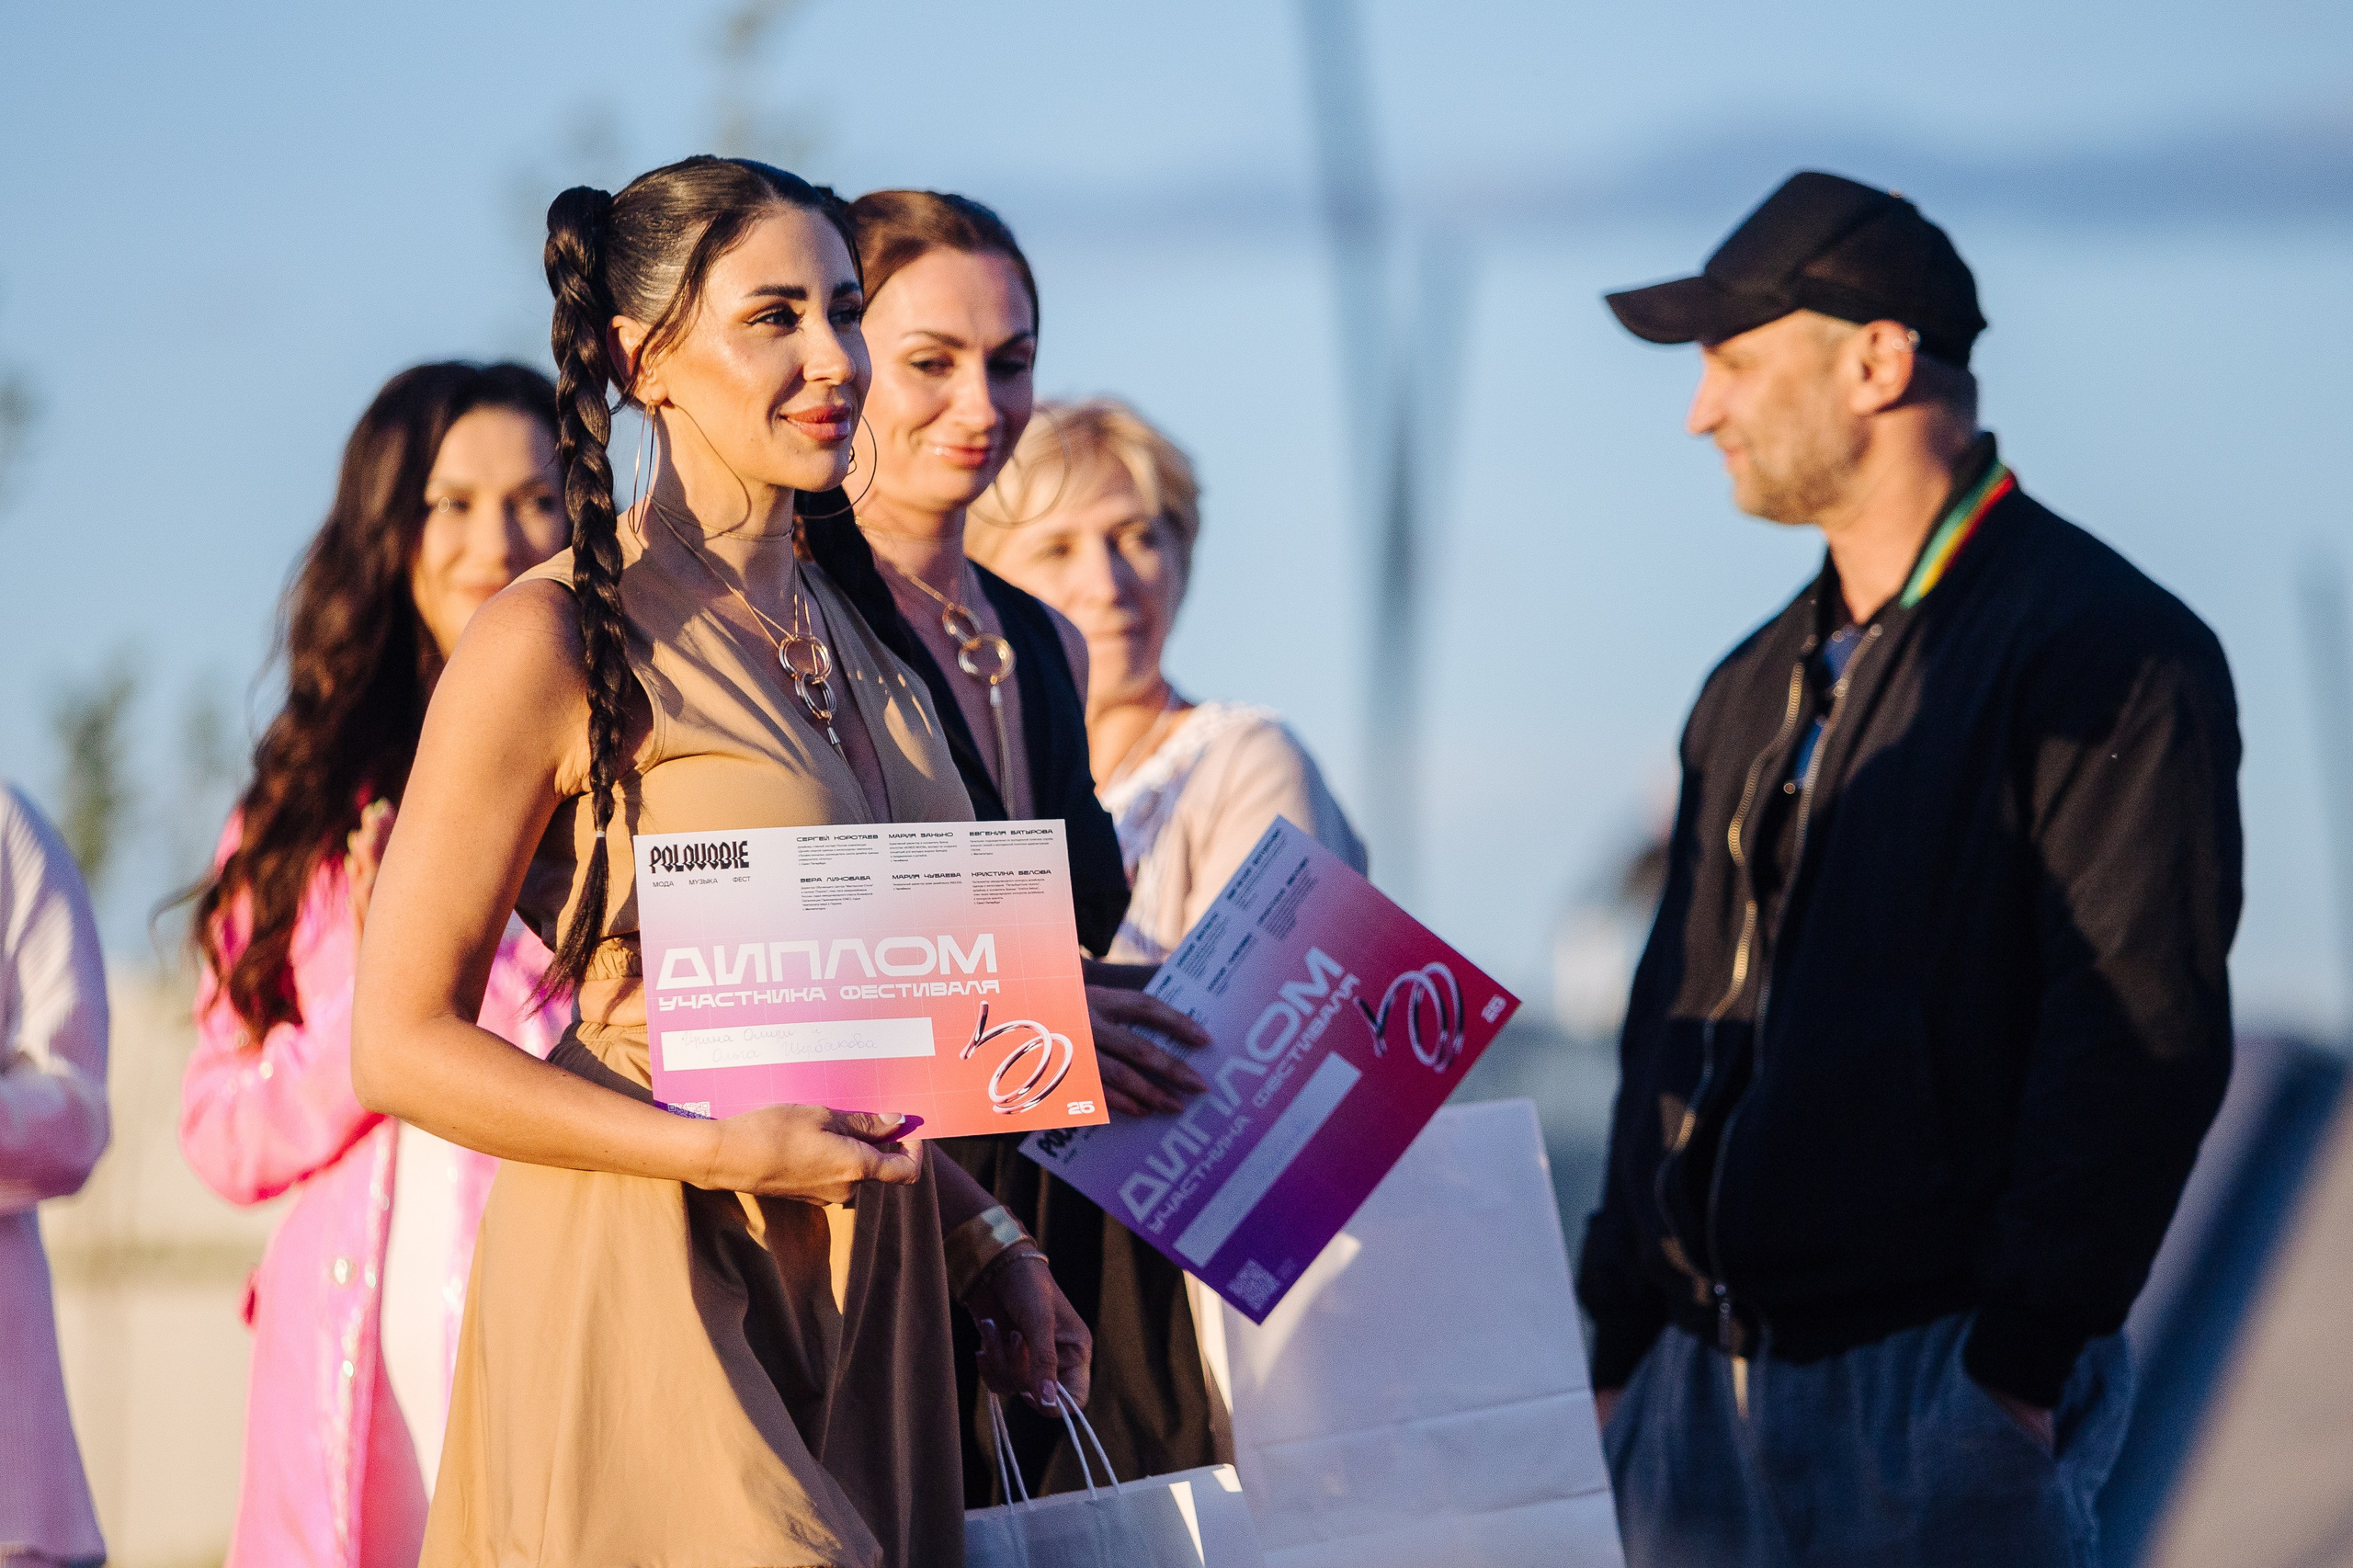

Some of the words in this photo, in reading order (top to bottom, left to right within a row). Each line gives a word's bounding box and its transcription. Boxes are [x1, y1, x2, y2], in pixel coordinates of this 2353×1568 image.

[655, 933, 998, 990] ДИПЛОМ
[658, 986, 826, 1012] УЧАСТНИКА
[839, 979, 1000, 1000] ФЕСТИВАЛЯ
[1066, 1100, 1096, 1115] 25
[1117, 947, 1343, 1223] ДИПЛОМ
